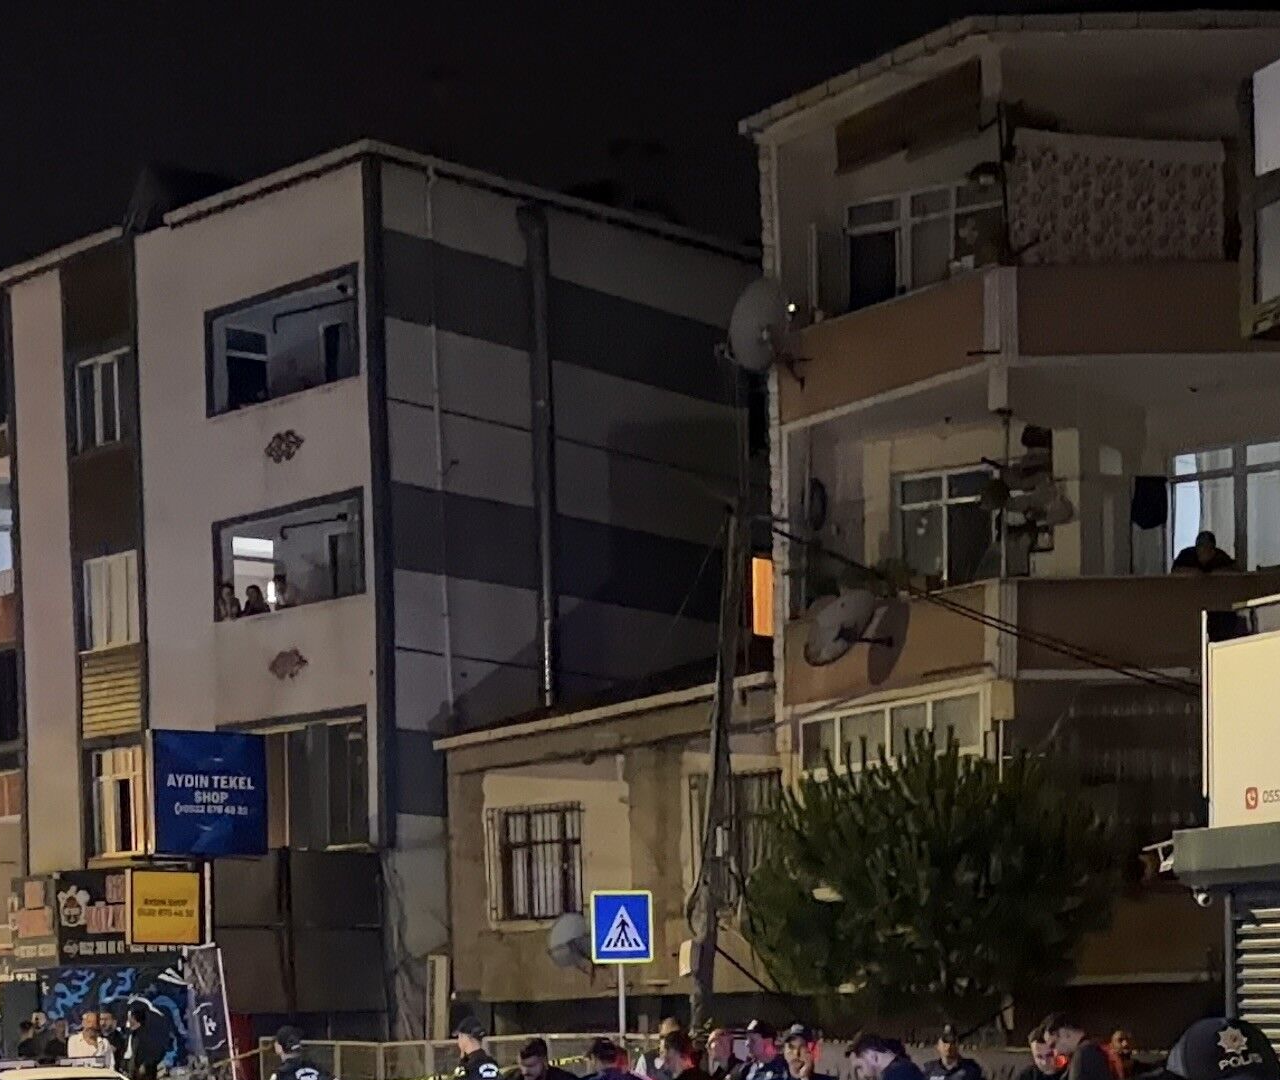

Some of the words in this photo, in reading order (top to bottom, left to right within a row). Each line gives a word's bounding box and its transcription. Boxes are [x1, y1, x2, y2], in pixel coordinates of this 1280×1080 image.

[166, 773, 209, 789] AYDIN
[211, 775, 255, 790] TEKEL
[193, 790, 228, 804] SHOP
